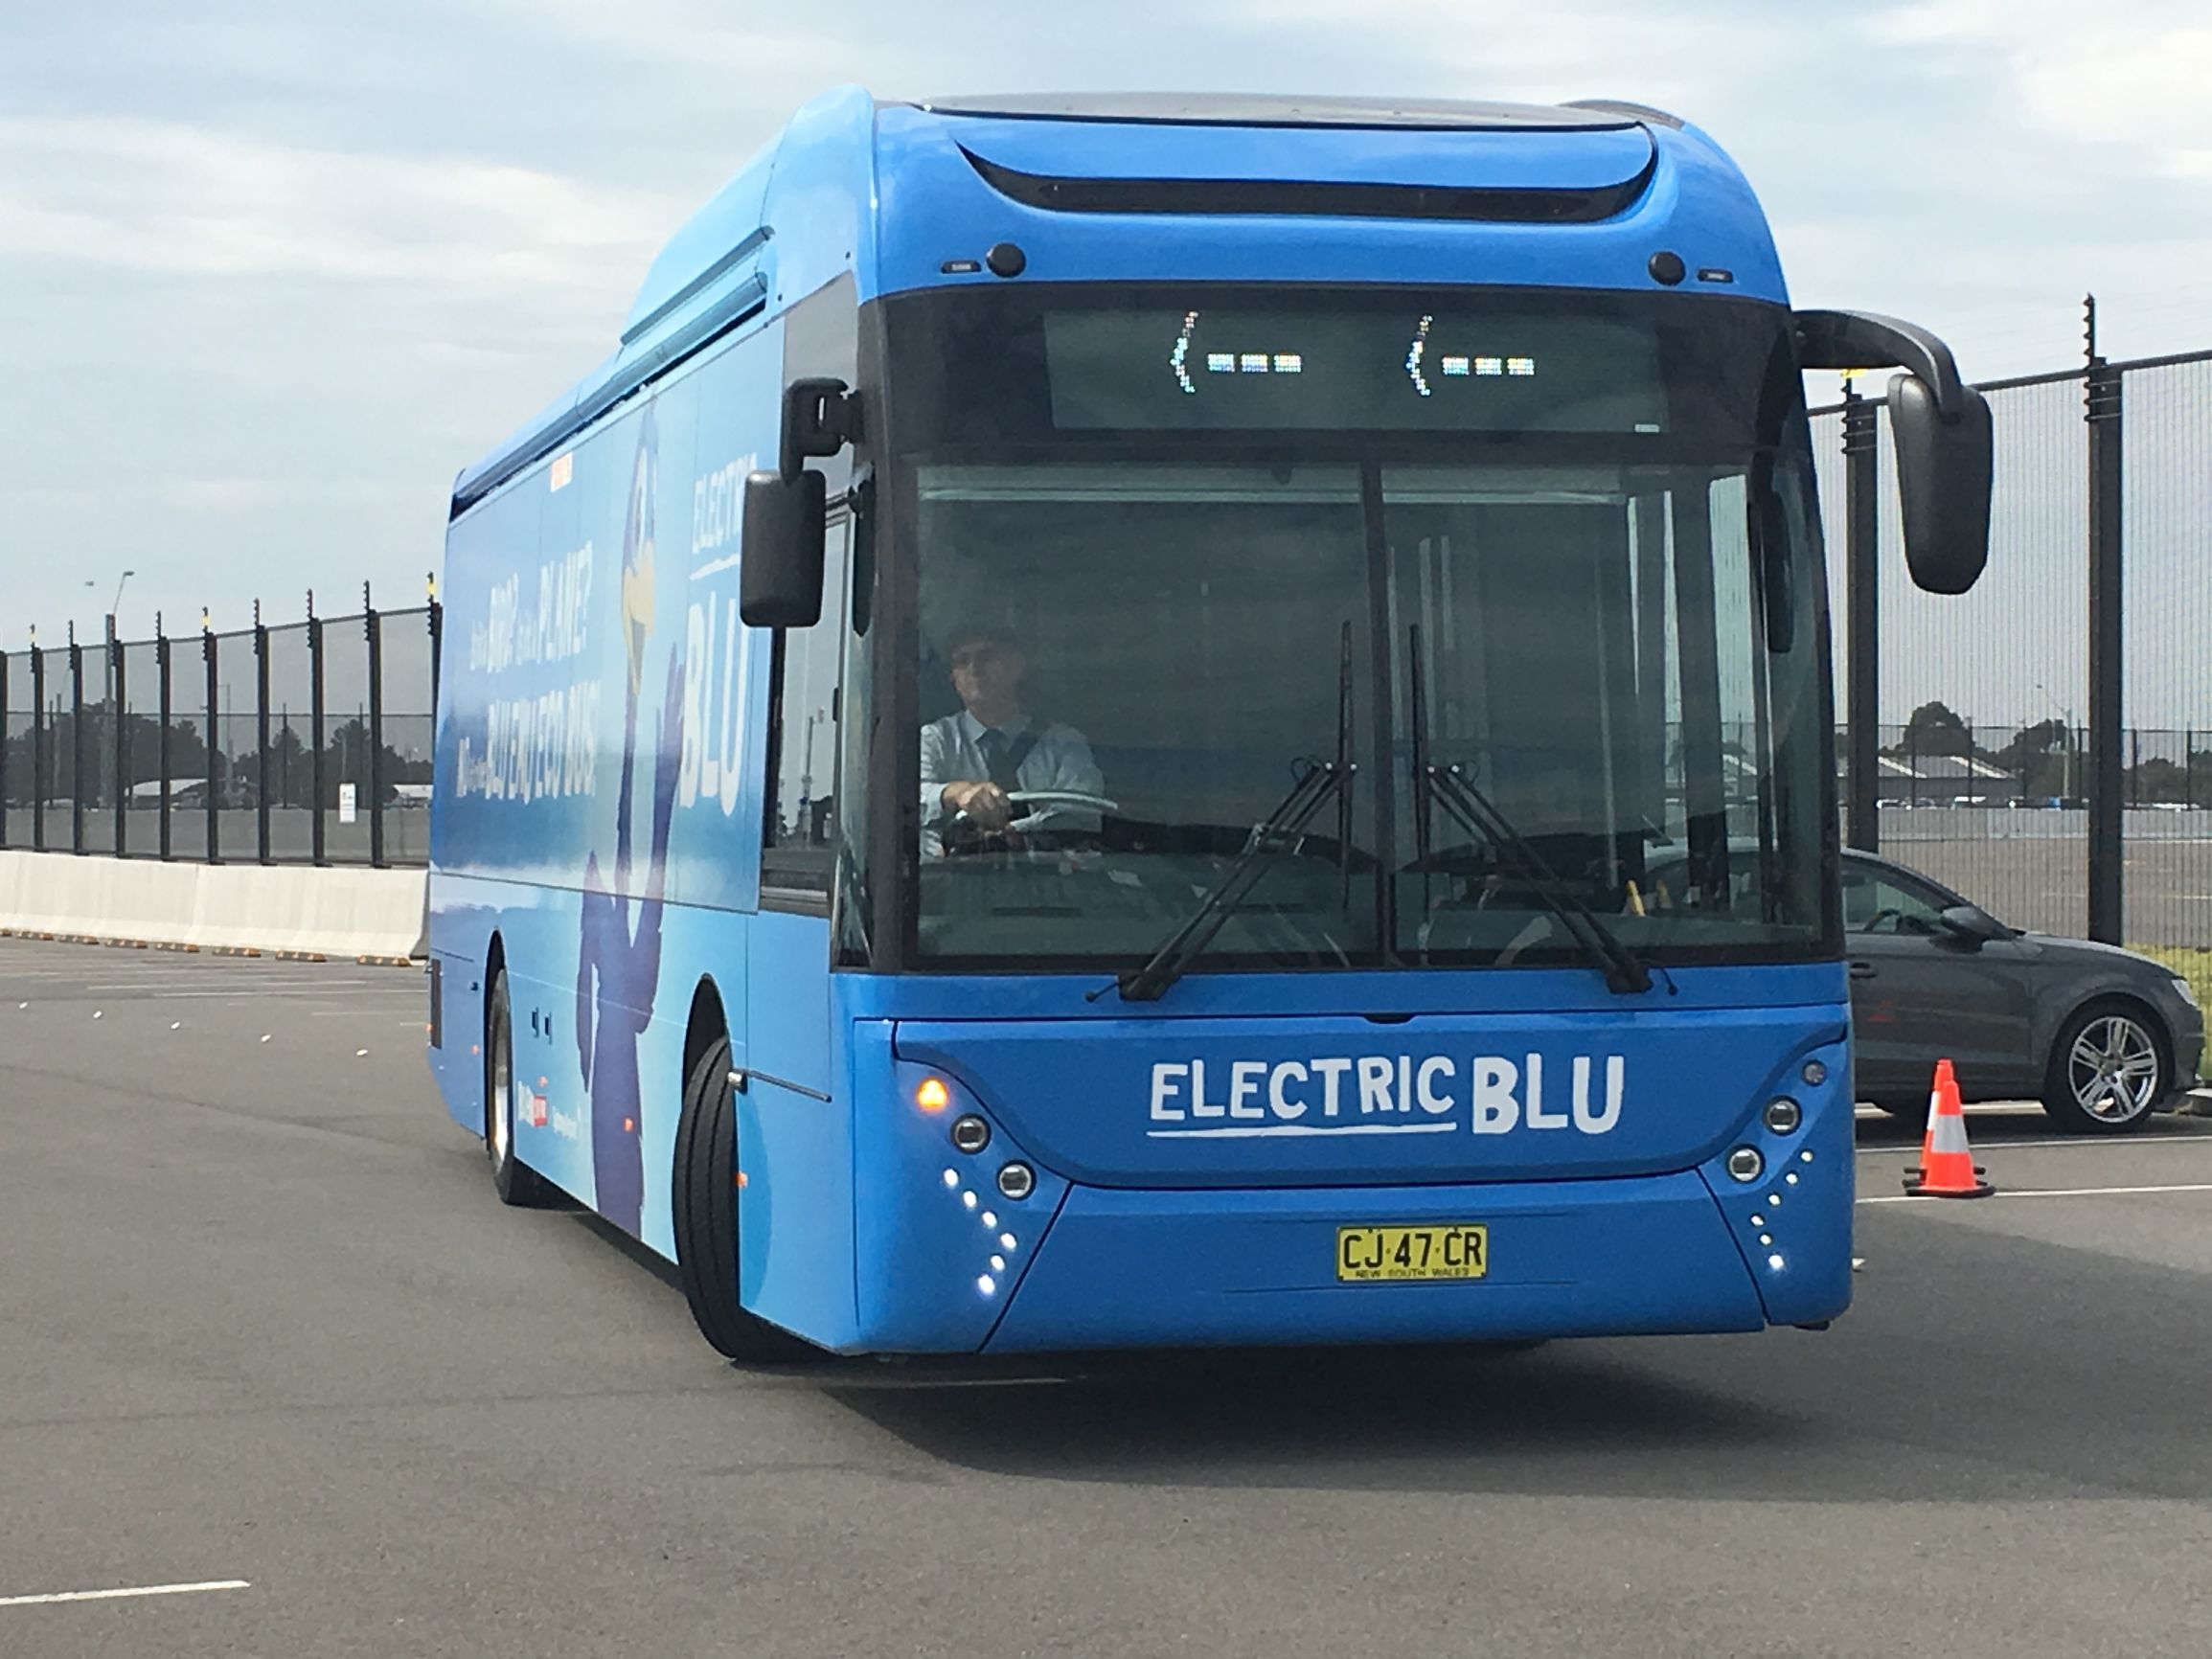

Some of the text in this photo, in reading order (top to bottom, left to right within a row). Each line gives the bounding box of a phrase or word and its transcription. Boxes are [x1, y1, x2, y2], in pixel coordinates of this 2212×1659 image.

[692, 452, 757, 554] ELECTR
[679, 591, 751, 817] BLU
[1150, 1053, 1625, 1134] ELECTRIC BLU
[1388, 1268, 1425, 1277] SOUTH
